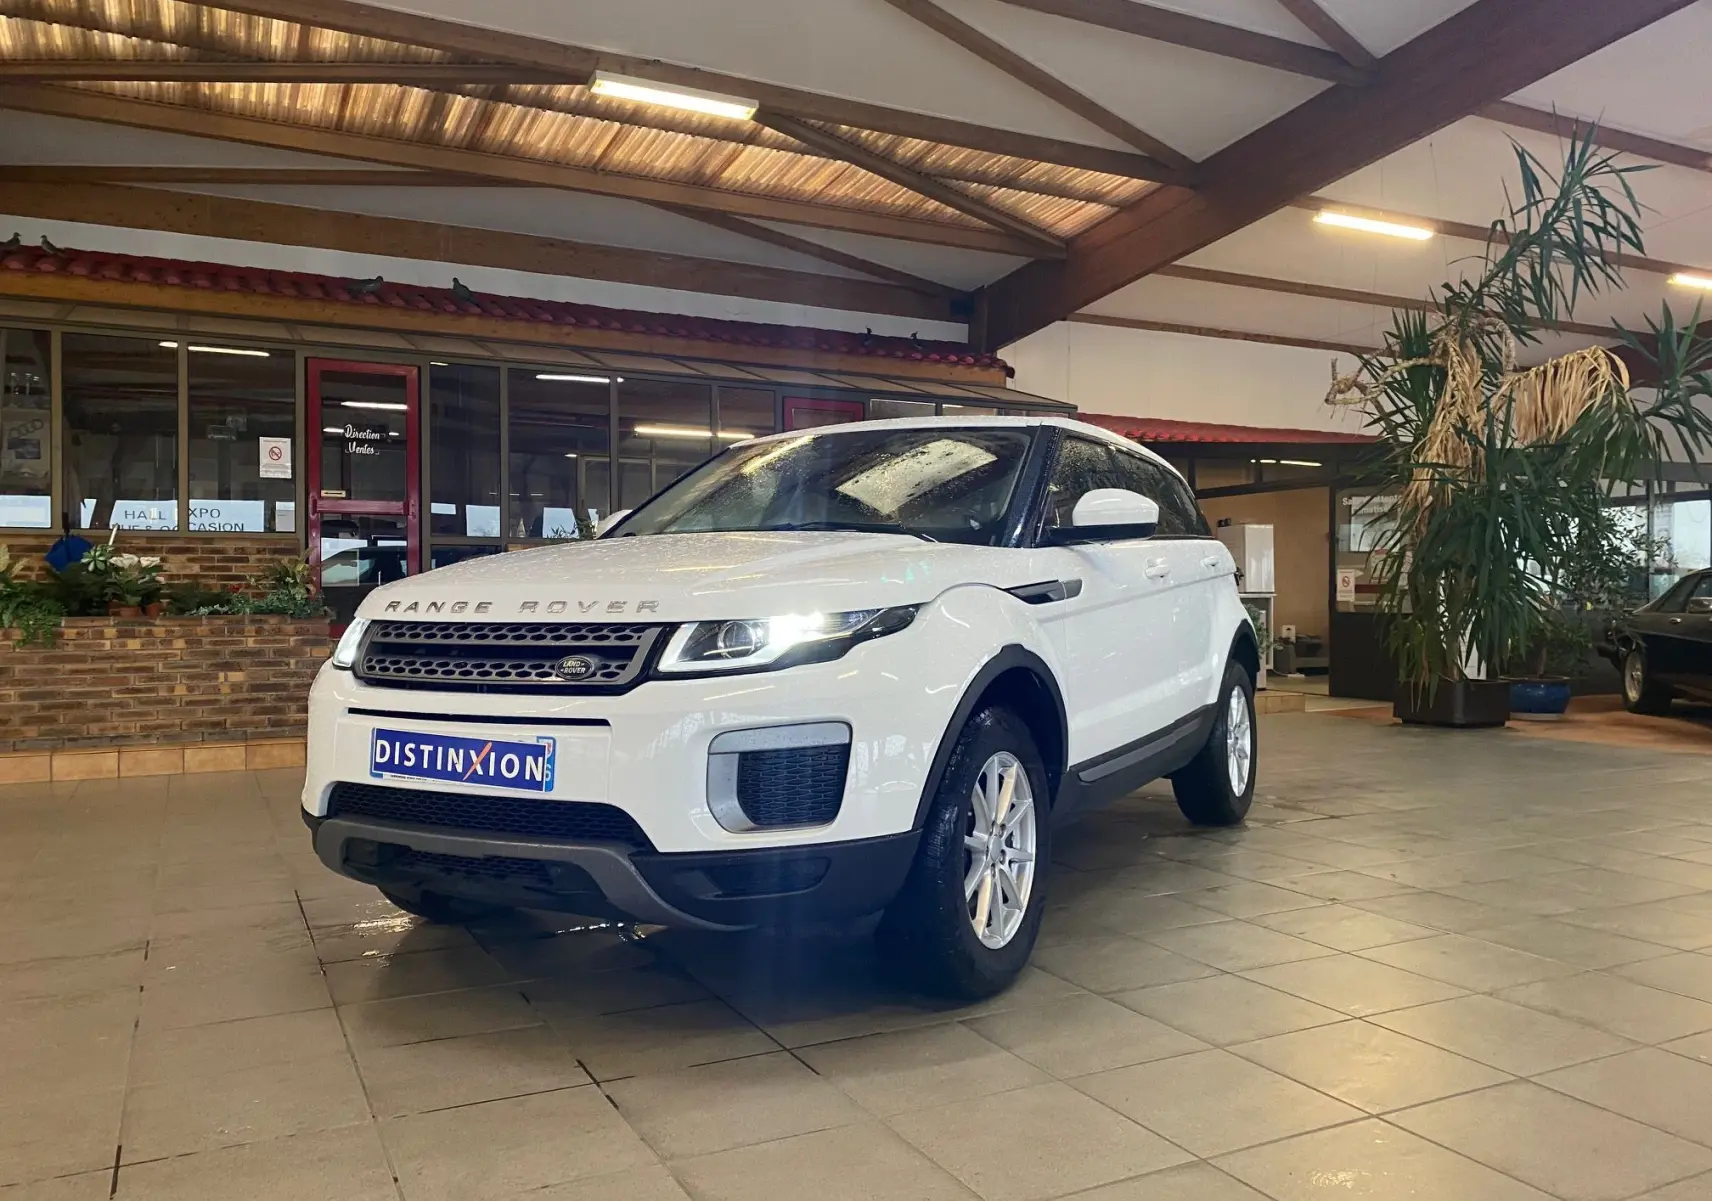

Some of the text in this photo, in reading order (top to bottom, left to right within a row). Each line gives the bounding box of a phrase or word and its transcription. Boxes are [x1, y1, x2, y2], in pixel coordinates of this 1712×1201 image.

[344, 424, 380, 440] Direction
[347, 441, 376, 455] Ventes
[124, 508, 221, 520] HALL XPO
[384, 600, 660, 614] RANGE ROVER
[563, 660, 581, 668] LAND
[375, 739, 543, 781] DISTINXION
